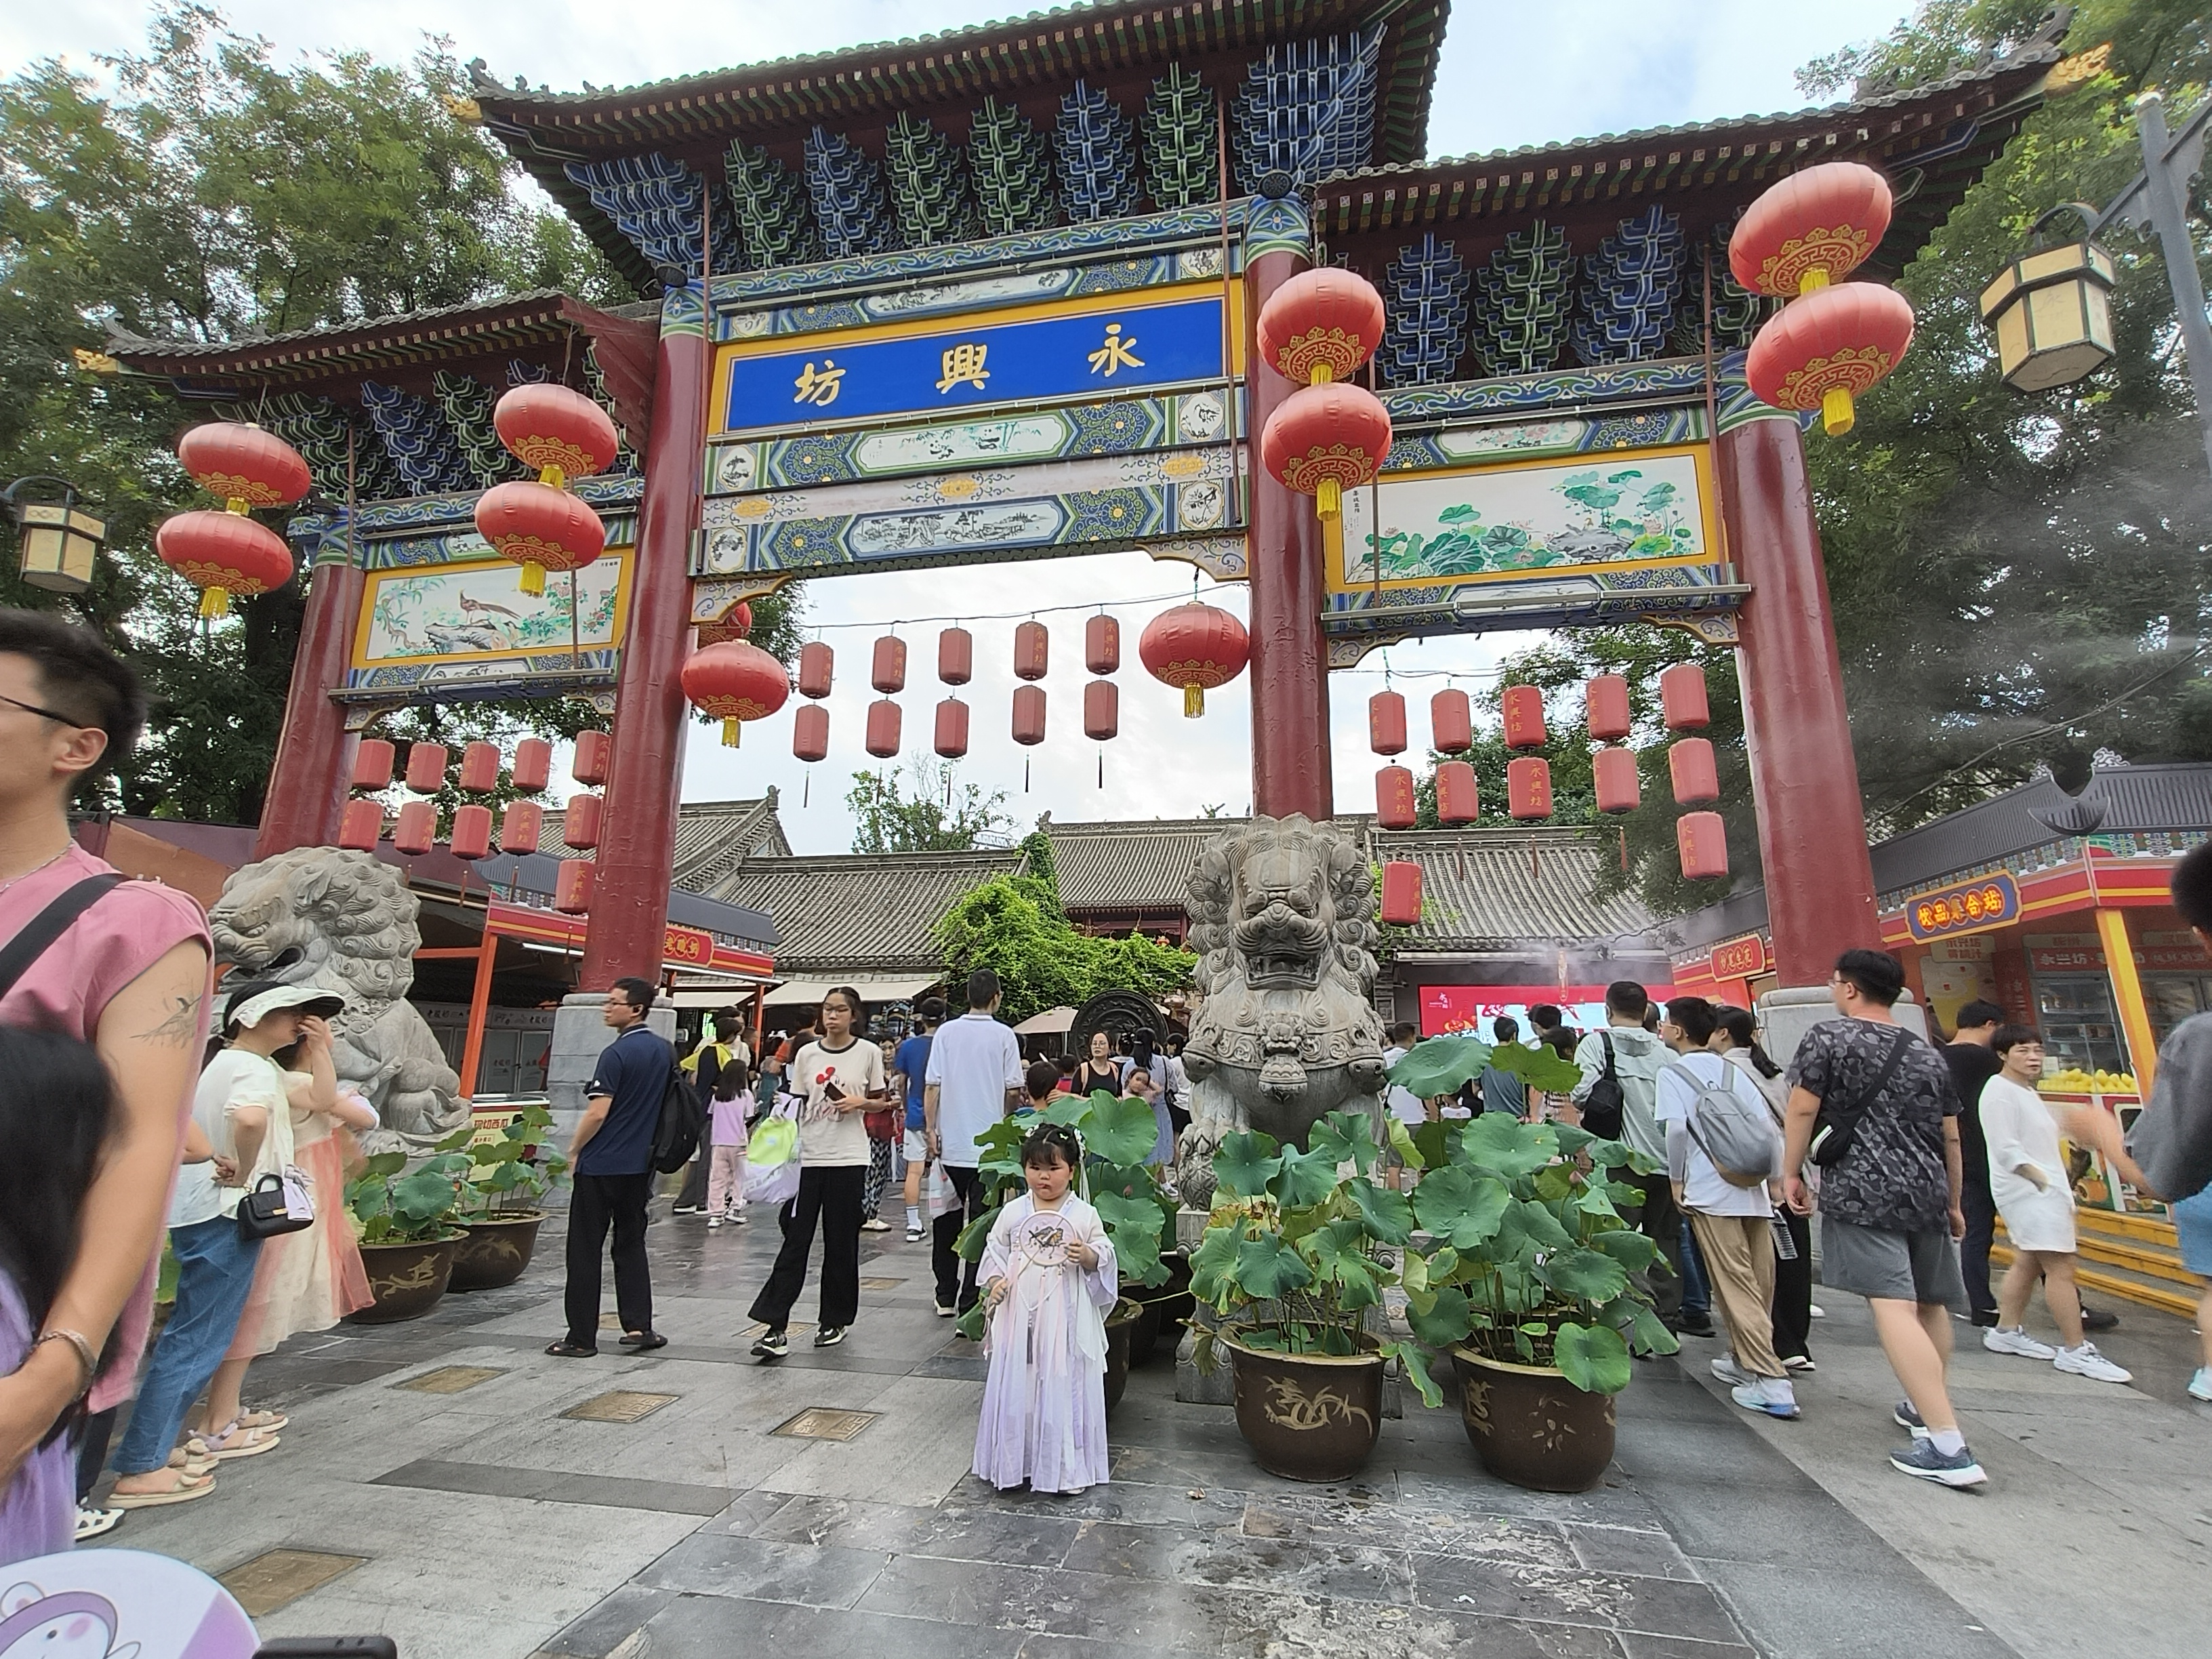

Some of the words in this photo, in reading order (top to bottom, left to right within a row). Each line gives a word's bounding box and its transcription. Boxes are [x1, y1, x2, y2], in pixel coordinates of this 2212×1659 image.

[1509, 692, 1523, 733] 永興坊
[1393, 773, 1408, 814] 永興坊
[1528, 764, 1544, 806] 永興坊
[516, 808, 533, 843] 永興坊
[568, 867, 587, 903] 永興坊
[1918, 890, 2002, 926] 饮品集合站
